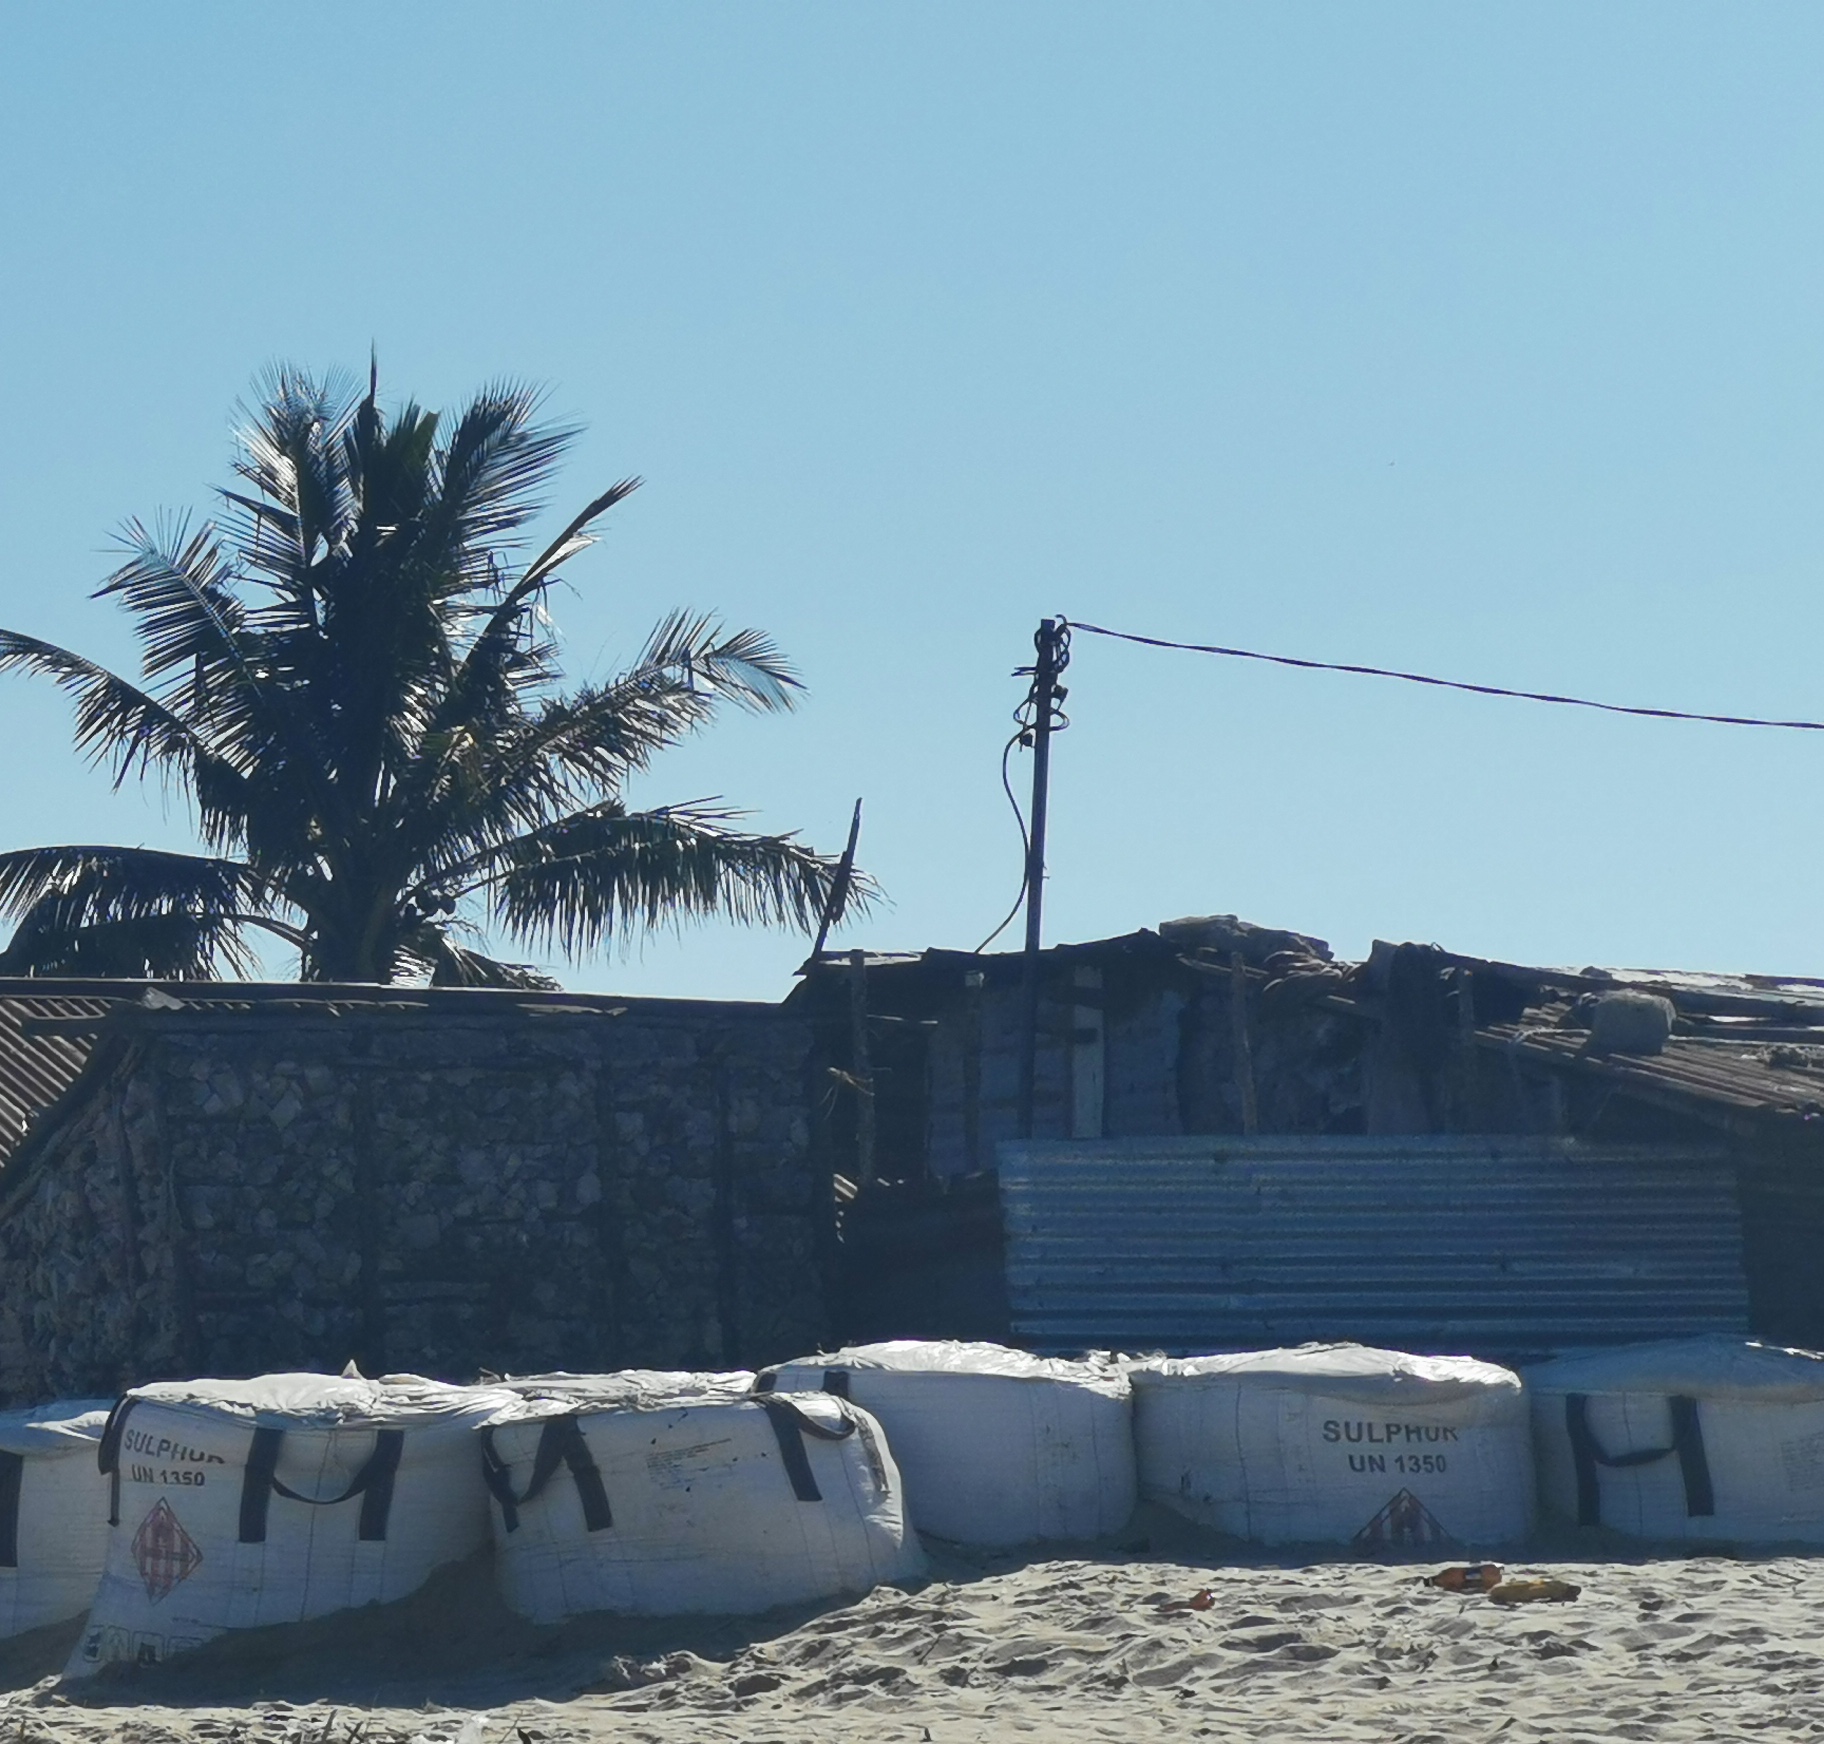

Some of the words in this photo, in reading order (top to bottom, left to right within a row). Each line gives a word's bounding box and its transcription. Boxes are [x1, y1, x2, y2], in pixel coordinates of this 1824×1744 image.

[1322, 1420, 1458, 1443] SULPHUR
[1348, 1454, 1386, 1473] UN
[1394, 1454, 1447, 1473] 1350
[131, 1464, 154, 1483] UN
[160, 1469, 205, 1486] 1350
